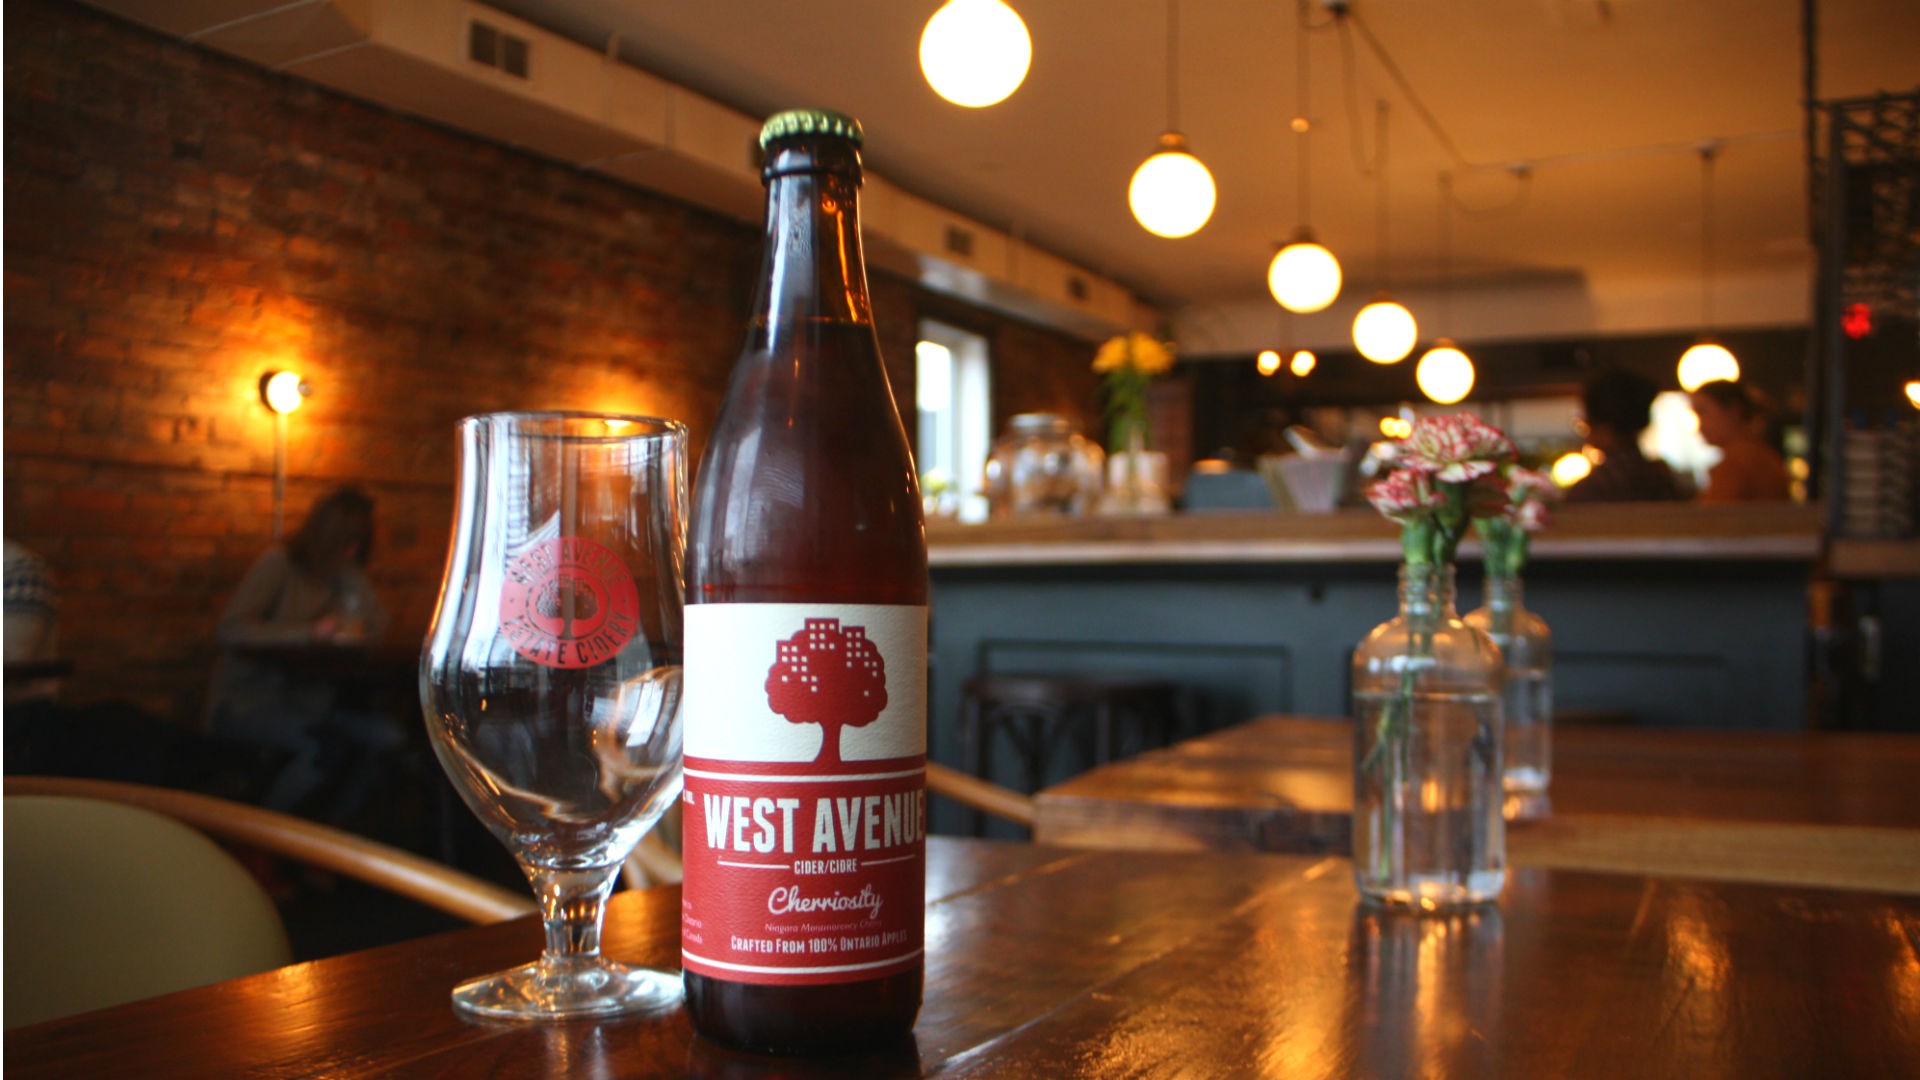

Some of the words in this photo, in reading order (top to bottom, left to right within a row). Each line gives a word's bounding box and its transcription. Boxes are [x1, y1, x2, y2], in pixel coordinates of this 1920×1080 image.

[511, 543, 555, 585] WEST
[575, 611, 635, 665] CIDERY
[703, 793, 800, 854] WEST
[812, 790, 923, 853] AVENUE
[794, 858, 858, 875] CIDER/CIDRE
[768, 882, 884, 919] Cherriosity
[808, 937, 838, 953] 100%
